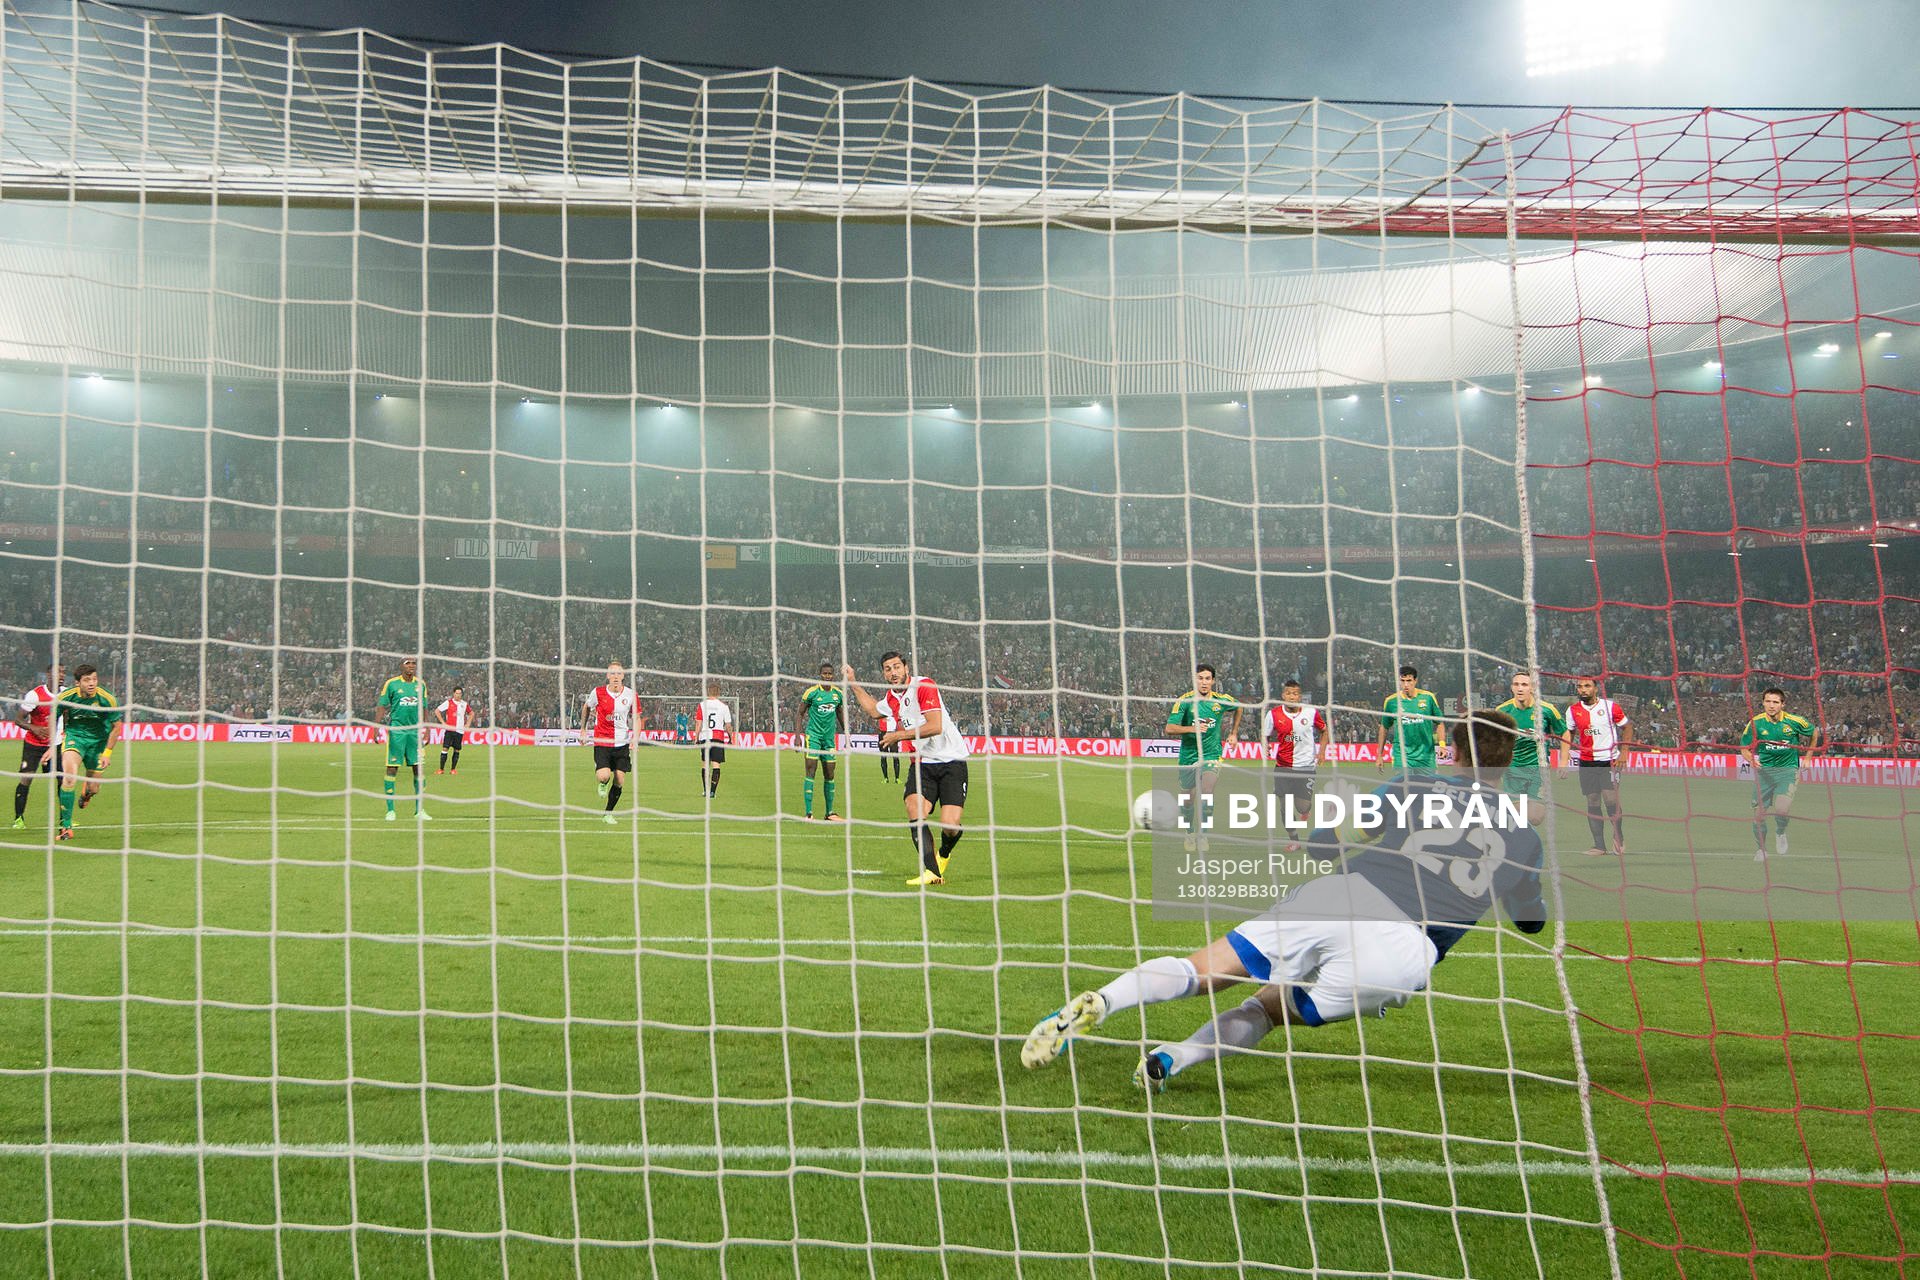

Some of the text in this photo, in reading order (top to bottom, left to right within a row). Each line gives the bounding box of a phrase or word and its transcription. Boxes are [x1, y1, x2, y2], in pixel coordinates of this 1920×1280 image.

[456, 539, 537, 559] LOUD LOYAL
[708, 713, 716, 729] 6
[1146, 745, 1180, 754] ATTE
